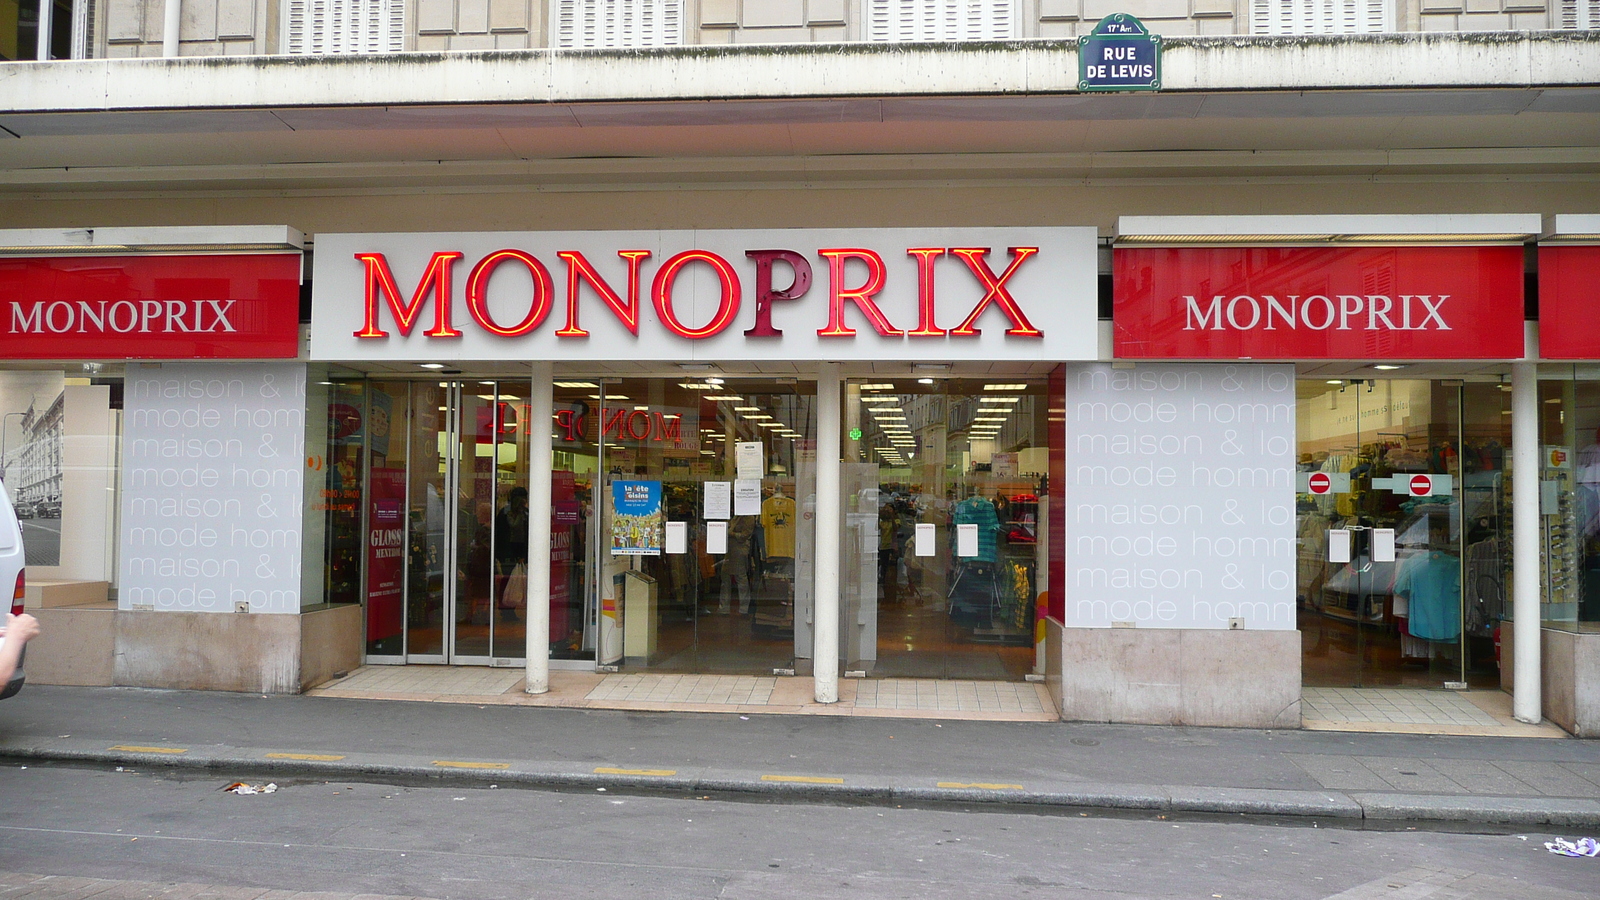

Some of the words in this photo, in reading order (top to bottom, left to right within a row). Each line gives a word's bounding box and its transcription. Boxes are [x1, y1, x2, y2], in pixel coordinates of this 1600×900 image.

[1104, 47, 1136, 61] RUE
[1087, 65, 1107, 78] DE
[1111, 64, 1153, 78] LEVIS
[353, 247, 1045, 339] MONOPRIX
[8, 299, 237, 334] MONOPRIX
[1182, 294, 1452, 331] MONOPRIX
[134, 374, 244, 398] maison
[260, 373, 280, 398] &
[1077, 366, 1202, 391] maison
[1220, 366, 1245, 391] &
[133, 403, 220, 427] mode
[1077, 397, 1177, 423] mode
[132, 433, 243, 457] maison
[258, 433, 279, 457] &
[1077, 429, 1202, 455] maison
[1220, 429, 1245, 455] &
[131, 463, 219, 487] mode
[1077, 461, 1177, 487] mode
[131, 493, 241, 517] maison
[257, 493, 278, 518] &
[1077, 499, 1202, 525] maison
[1220, 499, 1245, 525] &
[130, 522, 217, 546] mode
[371, 529, 402, 546] GLOSS
[1077, 530, 1177, 557] mode
[129, 553, 240, 577] maison
[255, 553, 276, 578] &
[1077, 563, 1202, 589] maison
[1220, 563, 1245, 589] &
[128, 583, 216, 607] mode
[1077, 595, 1177, 621] mode
